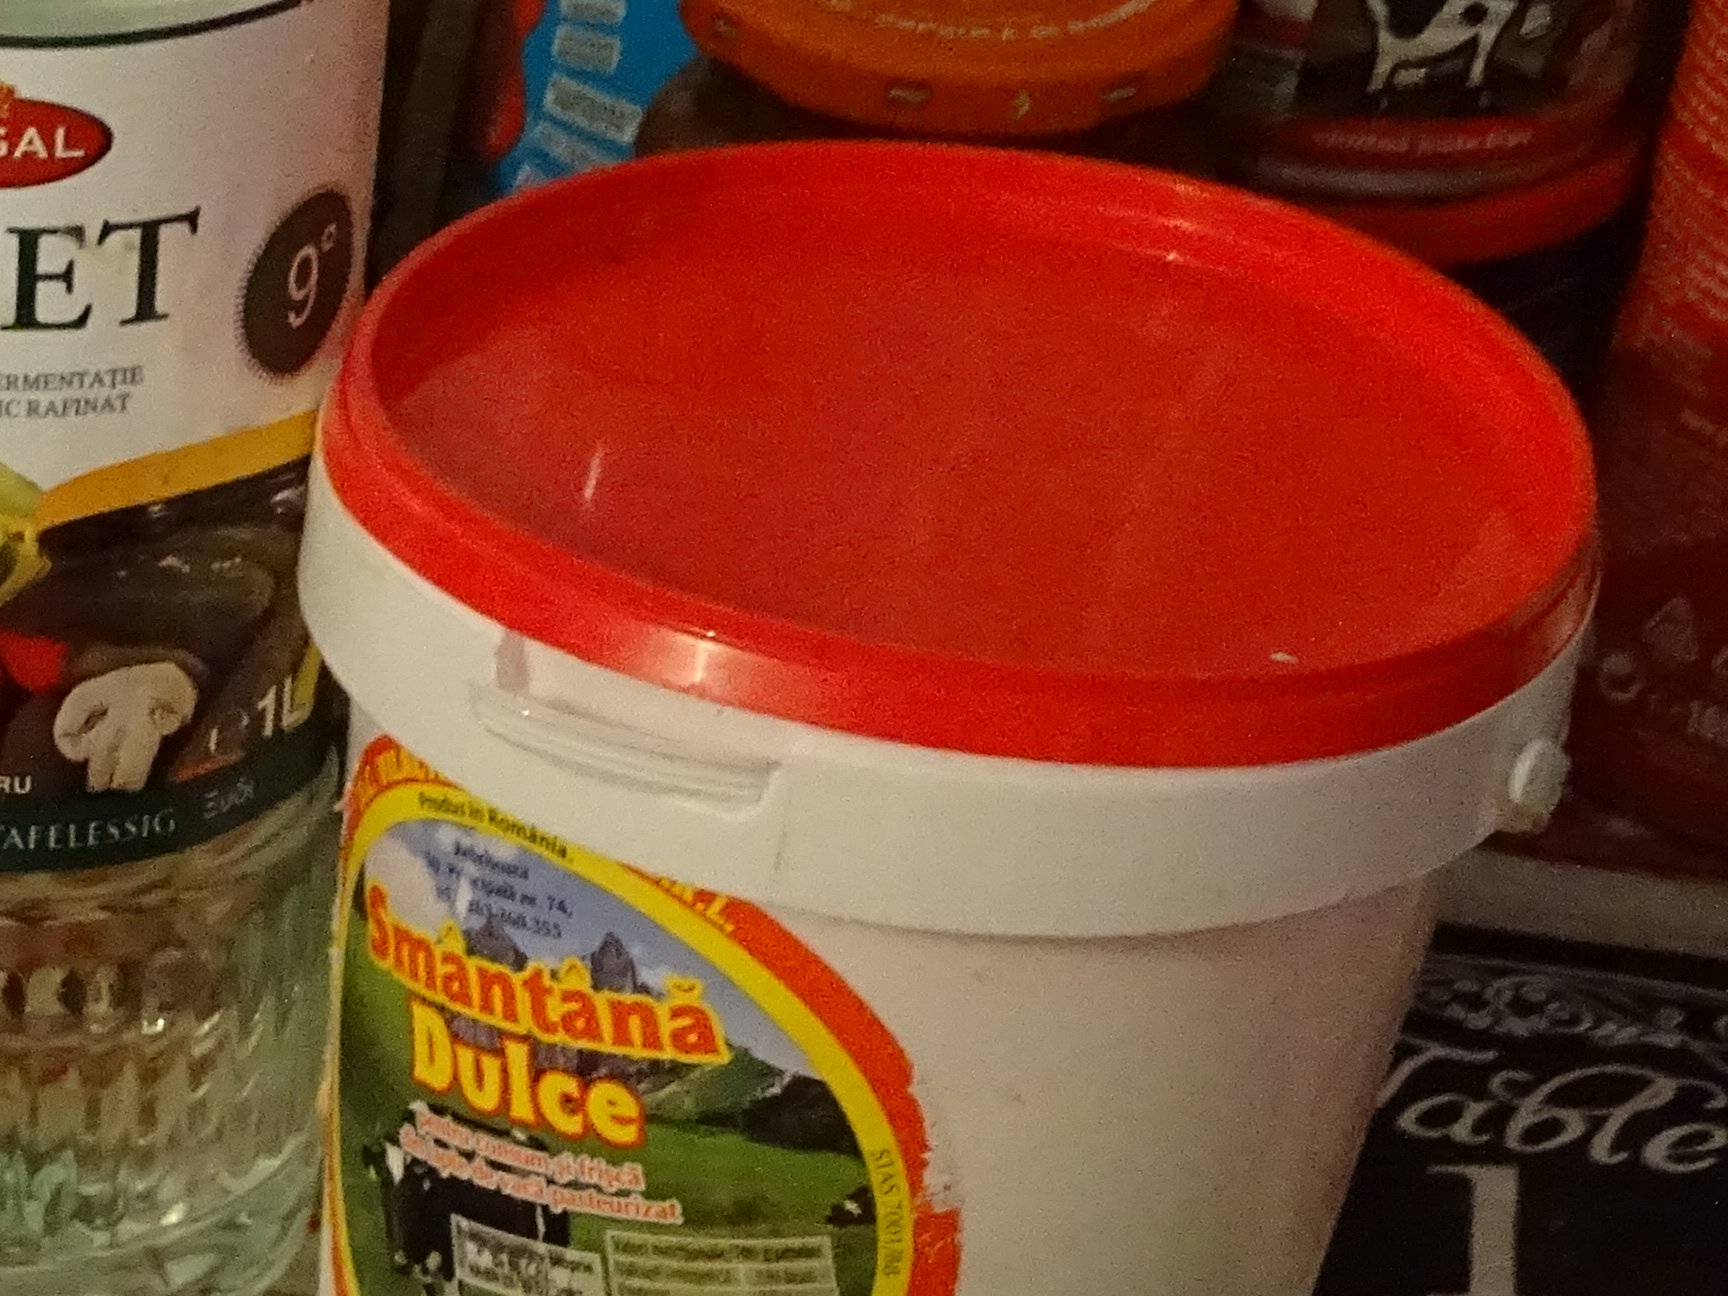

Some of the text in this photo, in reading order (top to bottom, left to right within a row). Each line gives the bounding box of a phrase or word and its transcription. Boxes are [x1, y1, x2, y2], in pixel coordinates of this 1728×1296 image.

[26, 392, 133, 419] RAFINAT
[367, 880, 729, 1060] Smântână
[412, 998, 646, 1146] Dulce
[1376, 1034, 1728, 1175] Table
